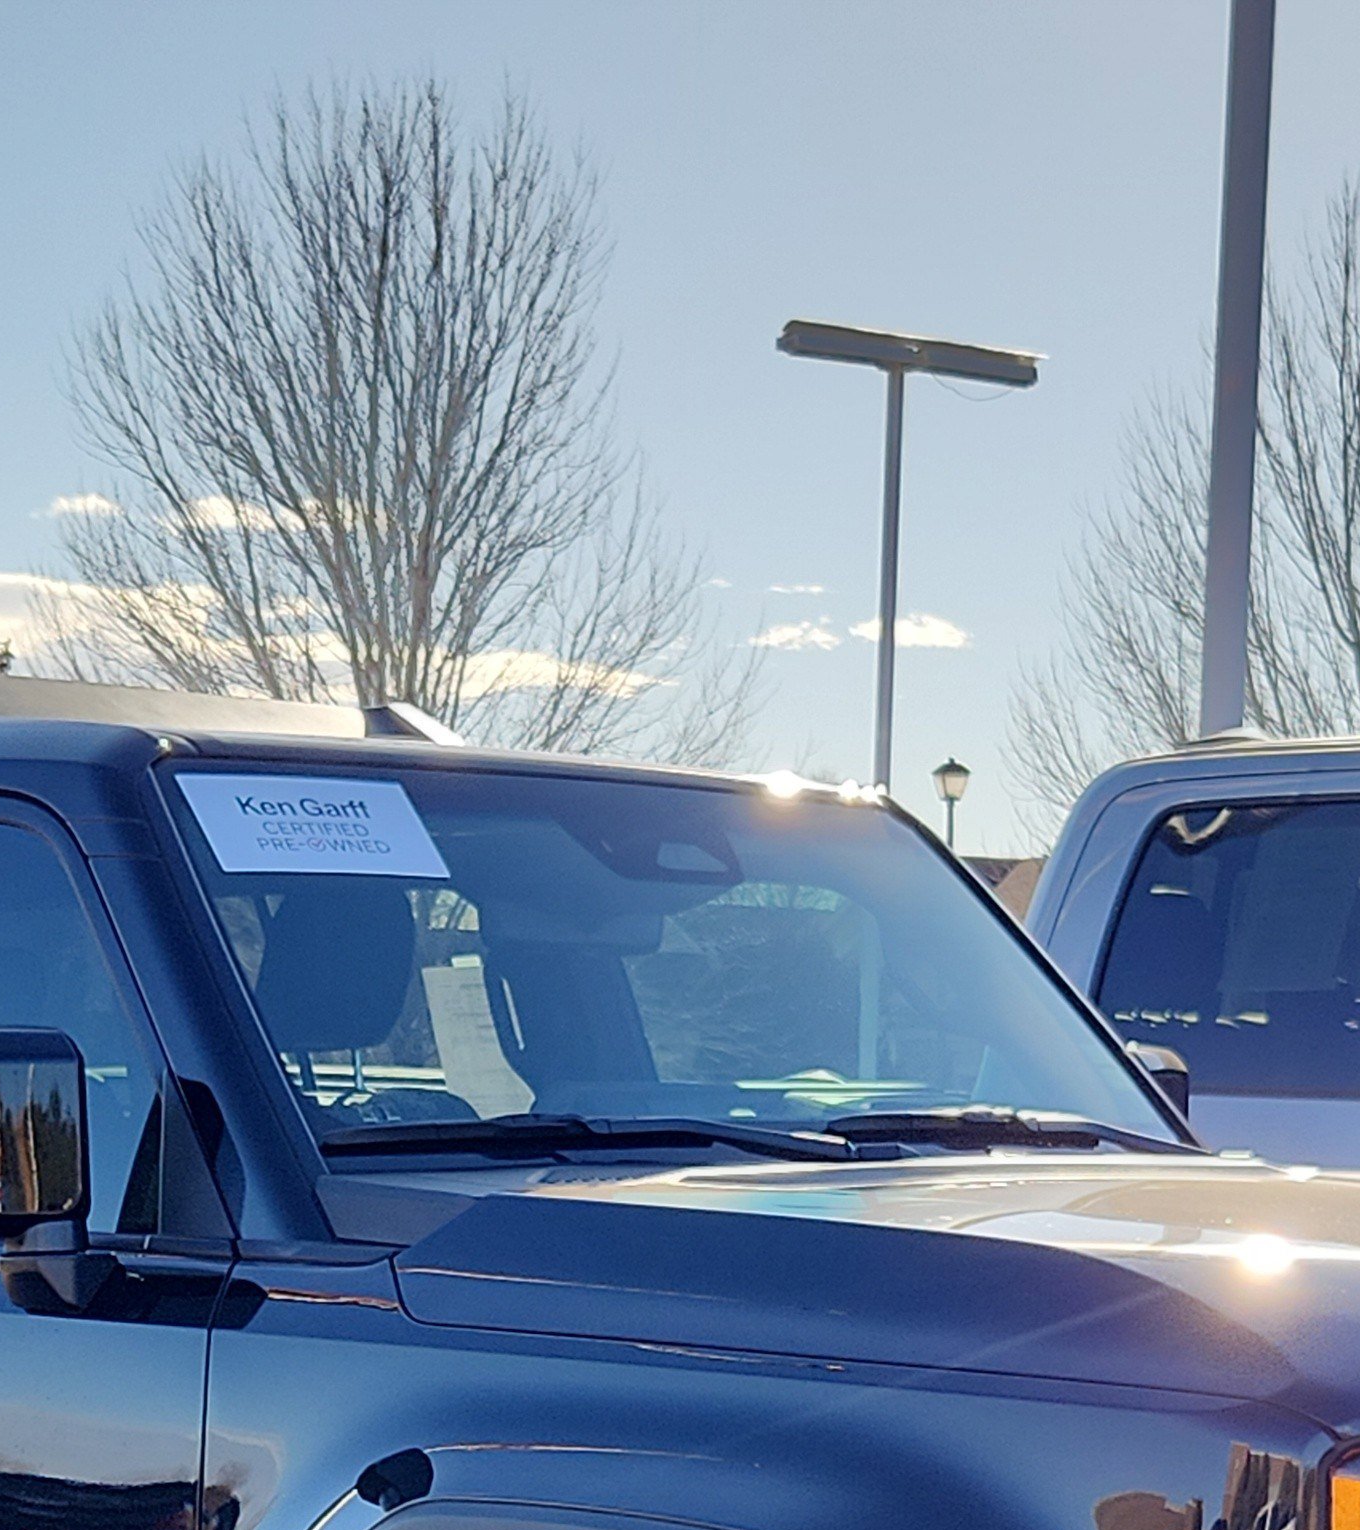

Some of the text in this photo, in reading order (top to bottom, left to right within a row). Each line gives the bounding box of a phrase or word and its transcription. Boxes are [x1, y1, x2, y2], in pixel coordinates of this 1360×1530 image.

[235, 796, 370, 819] Ken Garff
[262, 821, 370, 838] CERTIFIED
